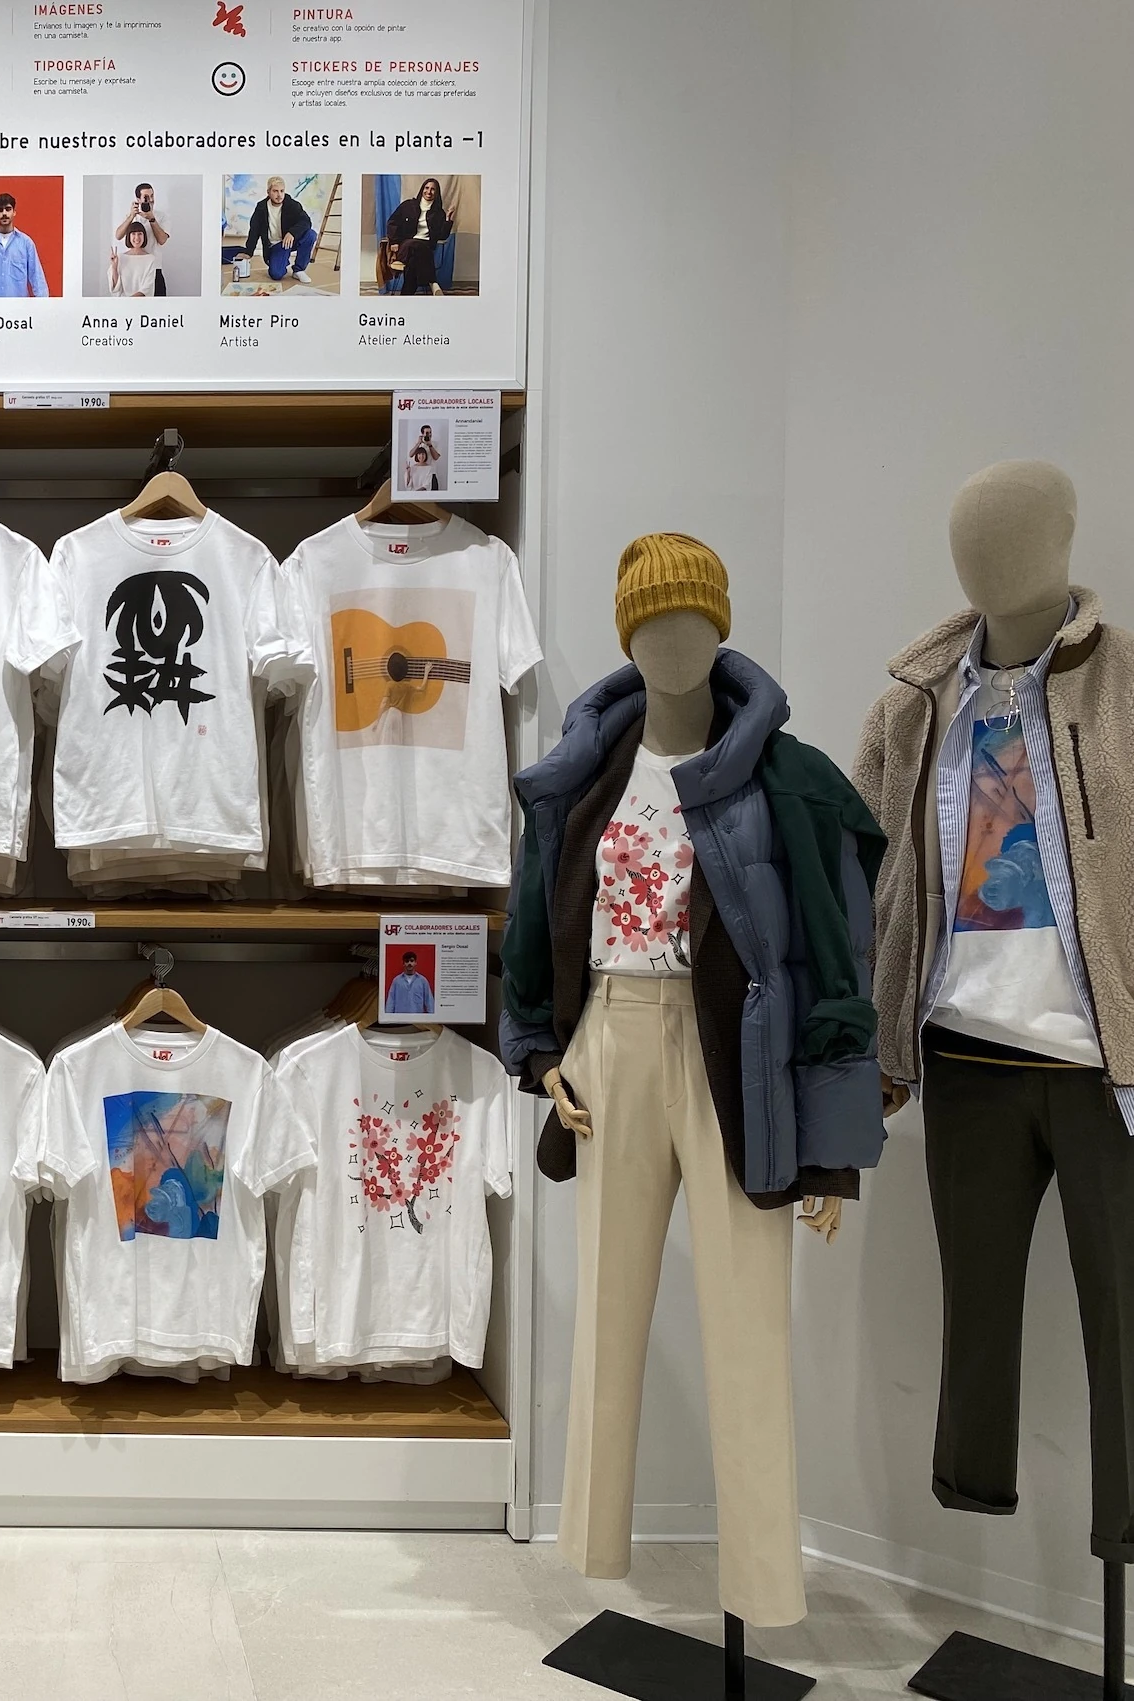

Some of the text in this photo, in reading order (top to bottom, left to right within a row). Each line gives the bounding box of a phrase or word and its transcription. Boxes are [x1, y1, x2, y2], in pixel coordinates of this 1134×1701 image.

[34, 0, 103, 16] IMÁGENES
[293, 8, 353, 20] PINTURA
[64, 22, 72, 30] tu
[73, 21, 98, 31] imagen
[99, 22, 104, 30] y
[106, 20, 113, 29] te
[114, 21, 122, 29] la
[123, 20, 162, 30] imprimimos
[292, 24, 301, 33] Se
[302, 24, 330, 32] creativo
[345, 24, 352, 32] la
[353, 23, 376, 33] opción
[376, 24, 386, 32] de
[387, 24, 407, 33] pintar
[291, 35, 301, 43] de
[302, 34, 328, 43] nuestra
[33, 56, 116, 72] TIPOGRAFÍA
[292, 60, 479, 73] STICKERS DE PERSONAJES
[33, 76, 136, 86] Escribe tu mensaje y exprésate
[291, 78, 315, 88] Escoge
[316, 78, 335, 86] entre
[336, 78, 362, 86] nuestra
[363, 78, 386, 88] amplia
[387, 79, 418, 87] colección
[419, 79, 428, 87] de
[291, 90, 304, 98] que
[306, 88, 333, 98] incluyen
[334, 88, 358, 97] diseños
[360, 89, 392, 97] exclusivos
[393, 89, 403, 97] de
[443, 88, 477, 99] preferidas
[291, 101, 296, 109] y
[298, 99, 322, 107] artistas
[38, 131, 117, 149] nuestros
[126, 130, 256, 148] colaboradores
[266, 130, 330, 148] locales
[339, 134, 360, 147] en
[370, 130, 386, 148] la
[395, 130, 453, 153] planta
[81, 314, 184, 332] Anna y Daniel
[219, 314, 299, 328] Mister Piro
[358, 313, 405, 327] Gavina
[81, 335, 134, 347] Creativos
[219, 336, 259, 347] Artista
[358, 334, 450, 346] Atelier Aletheia
